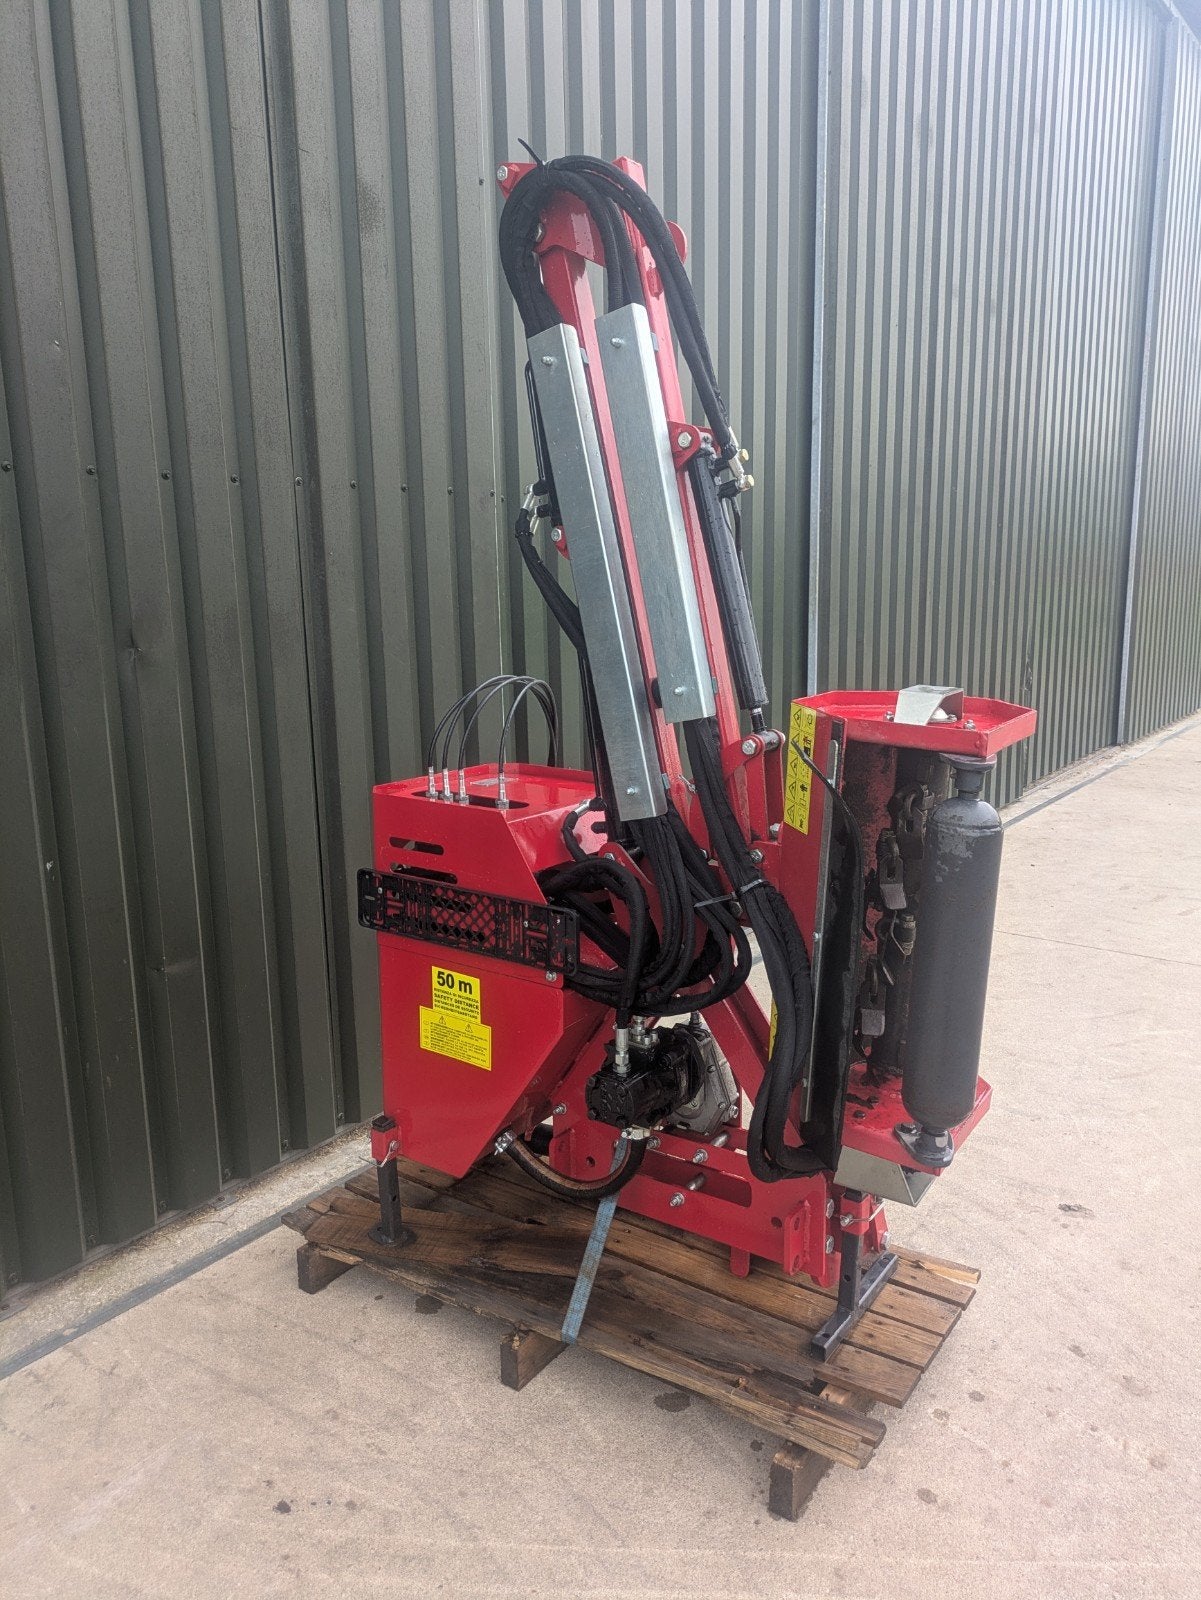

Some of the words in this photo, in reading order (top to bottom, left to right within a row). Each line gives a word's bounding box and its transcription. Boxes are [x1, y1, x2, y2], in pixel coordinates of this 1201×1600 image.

[437, 971, 454, 989] 50
[458, 980, 472, 995] m
[434, 993, 453, 1001] SAFETY
